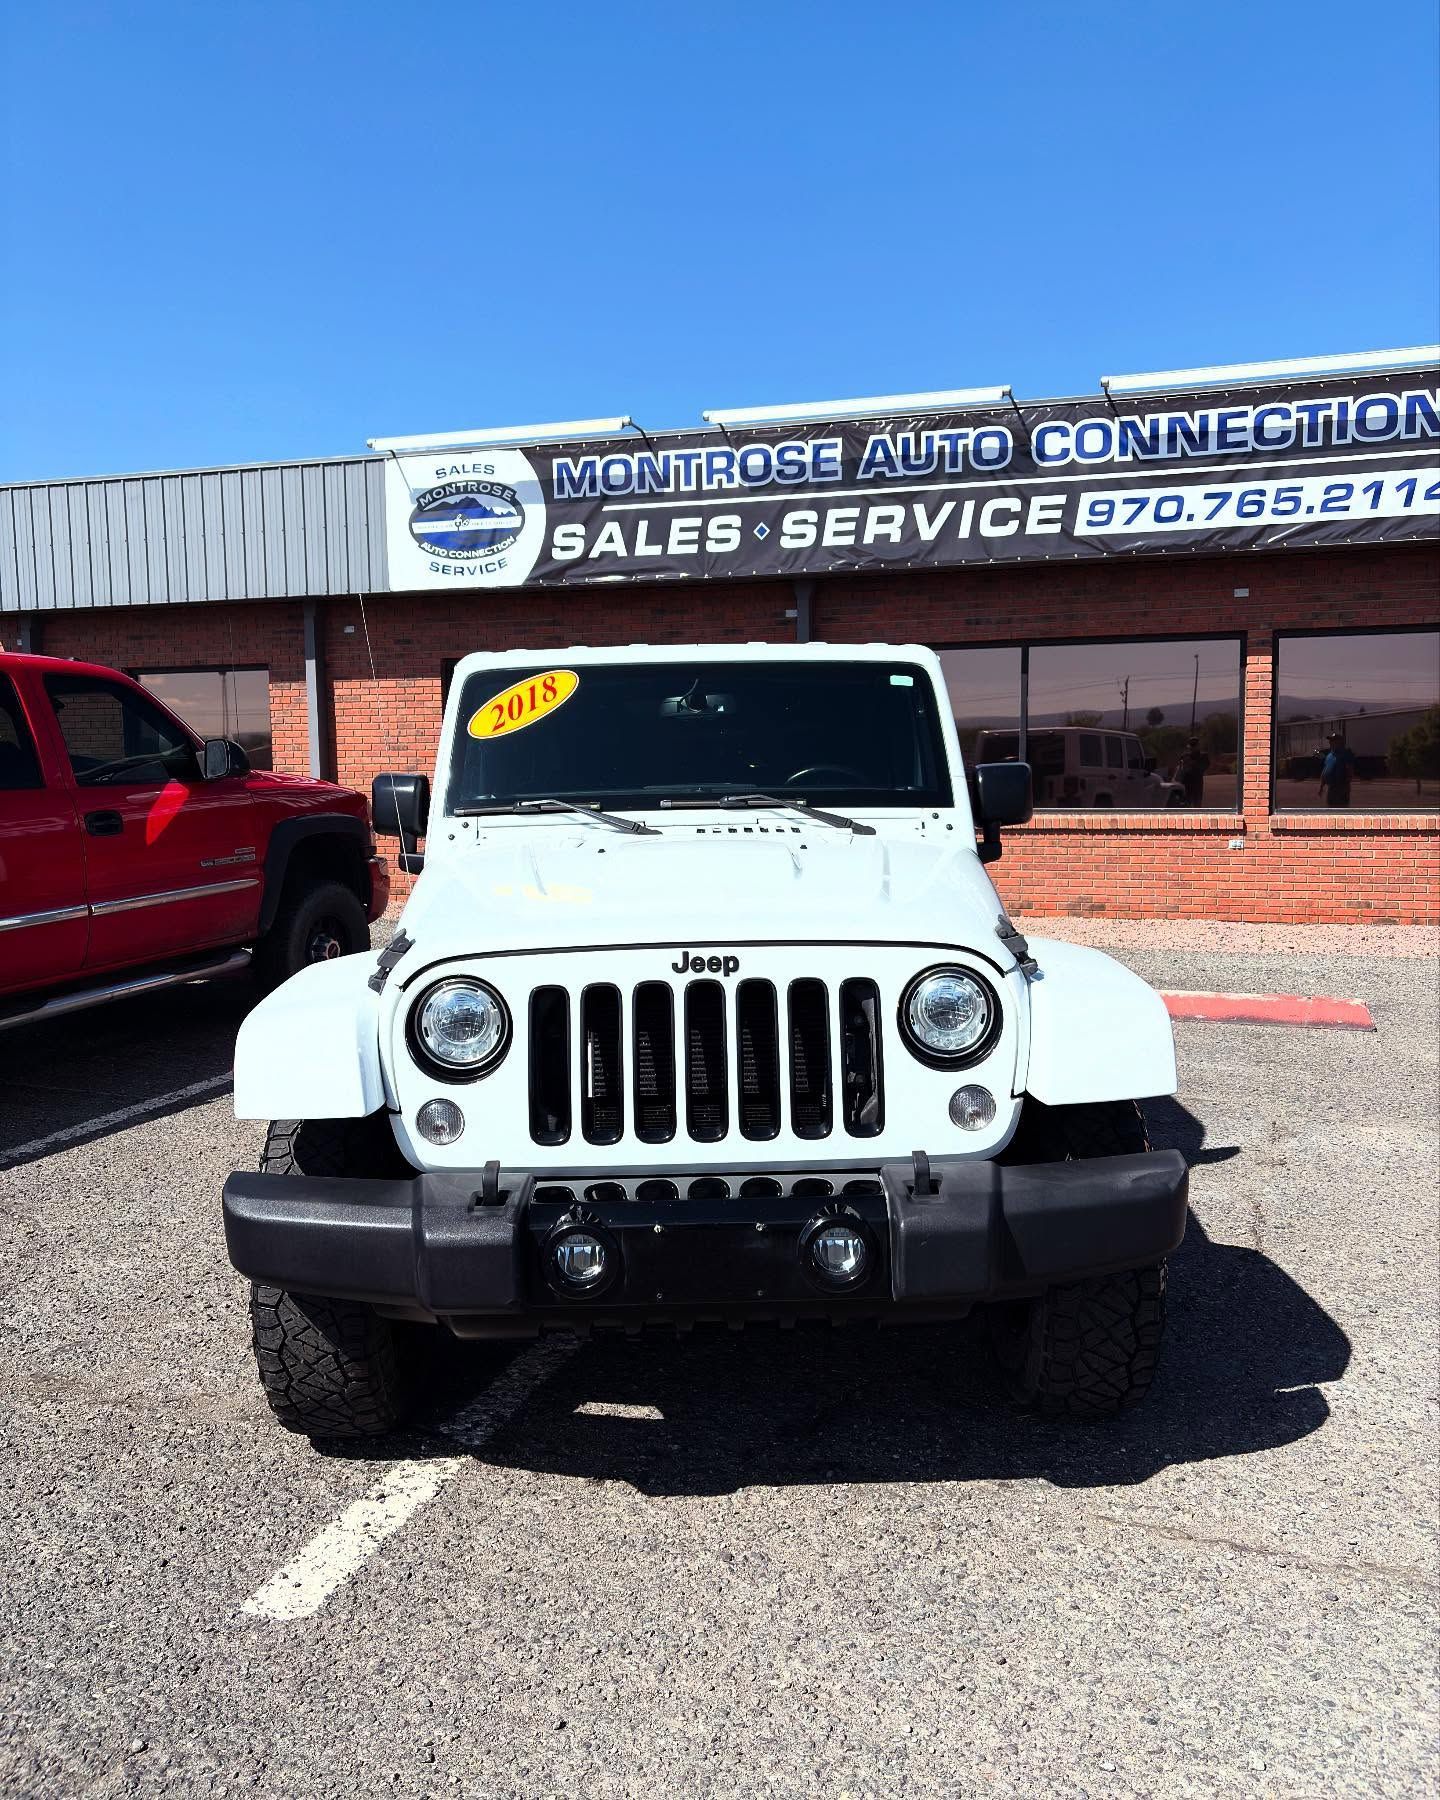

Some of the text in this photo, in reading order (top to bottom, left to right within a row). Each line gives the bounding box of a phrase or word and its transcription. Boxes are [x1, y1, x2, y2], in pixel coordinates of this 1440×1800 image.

[552, 388, 1440, 499] MONTROSE AUTO CONNECTION
[435, 464, 495, 479] SALES
[419, 481, 514, 507] MONTROSE
[551, 494, 1067, 560] SALES SERVICE
[421, 536, 515, 559] AUTO CONNECTION
[429, 558, 508, 576] SERVICE
[490, 675, 558, 732] 2018
[671, 951, 740, 977] Jeep
